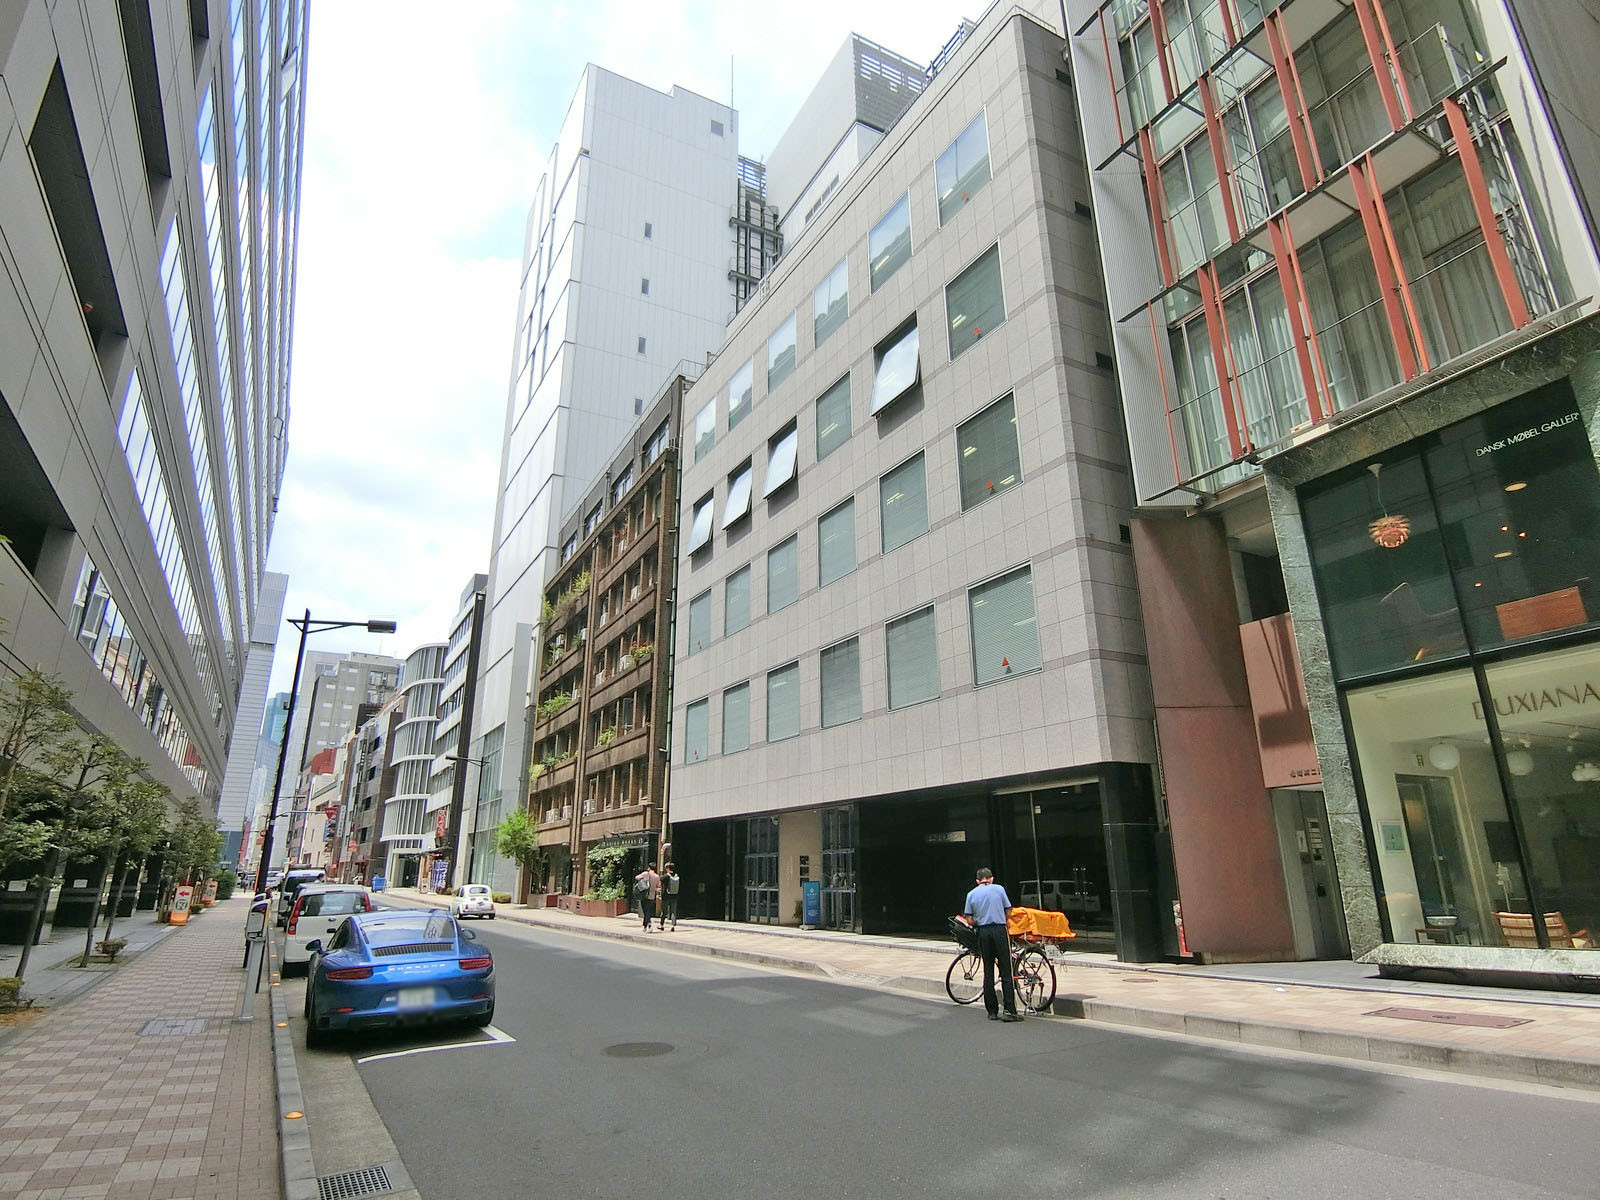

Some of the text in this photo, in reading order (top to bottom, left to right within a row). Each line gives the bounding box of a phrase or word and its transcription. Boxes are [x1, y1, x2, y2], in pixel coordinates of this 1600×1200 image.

[1475, 412, 1579, 457] DANSK MØBEL GALLER
